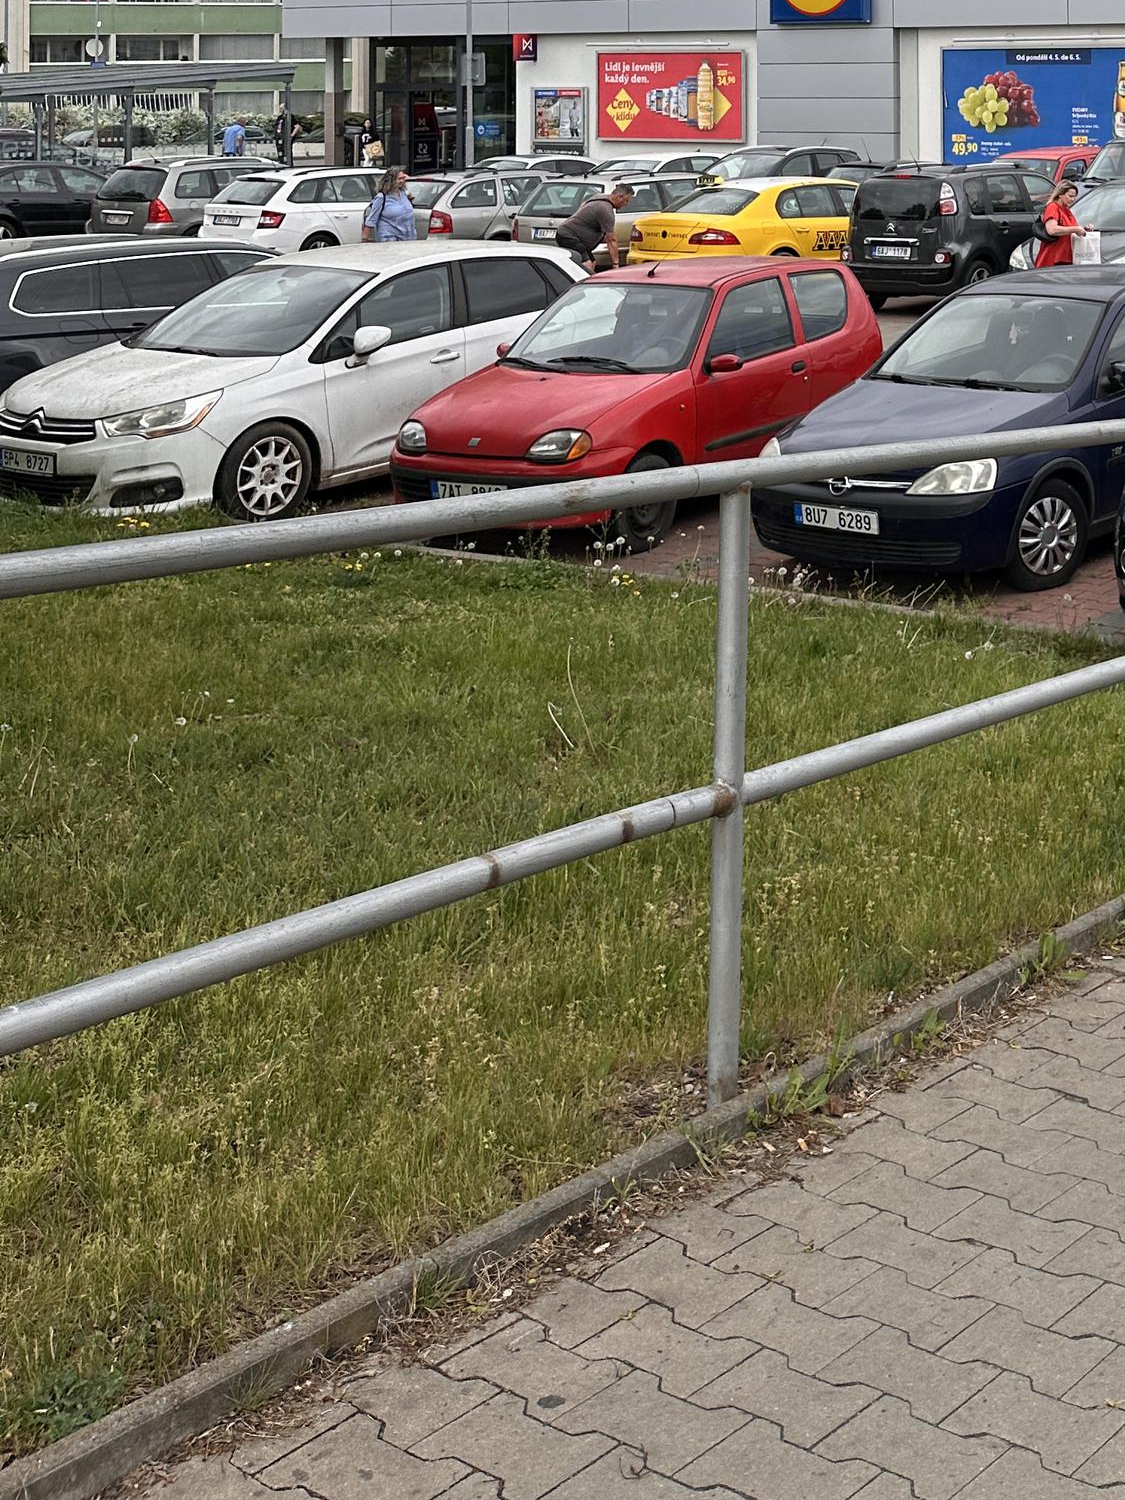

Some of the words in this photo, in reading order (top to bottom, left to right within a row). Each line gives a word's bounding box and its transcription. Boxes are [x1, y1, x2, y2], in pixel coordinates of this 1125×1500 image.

[605, 62, 621, 72] Lidl
[622, 62, 631, 73] je
[632, 62, 665, 74] levnější
[605, 73, 629, 85] každý
[631, 74, 650, 83] den.
[611, 99, 634, 110] Ceny
[26, 455, 49, 471] 8727
[805, 507, 828, 525] 8U7
[838, 512, 871, 531] 6289
